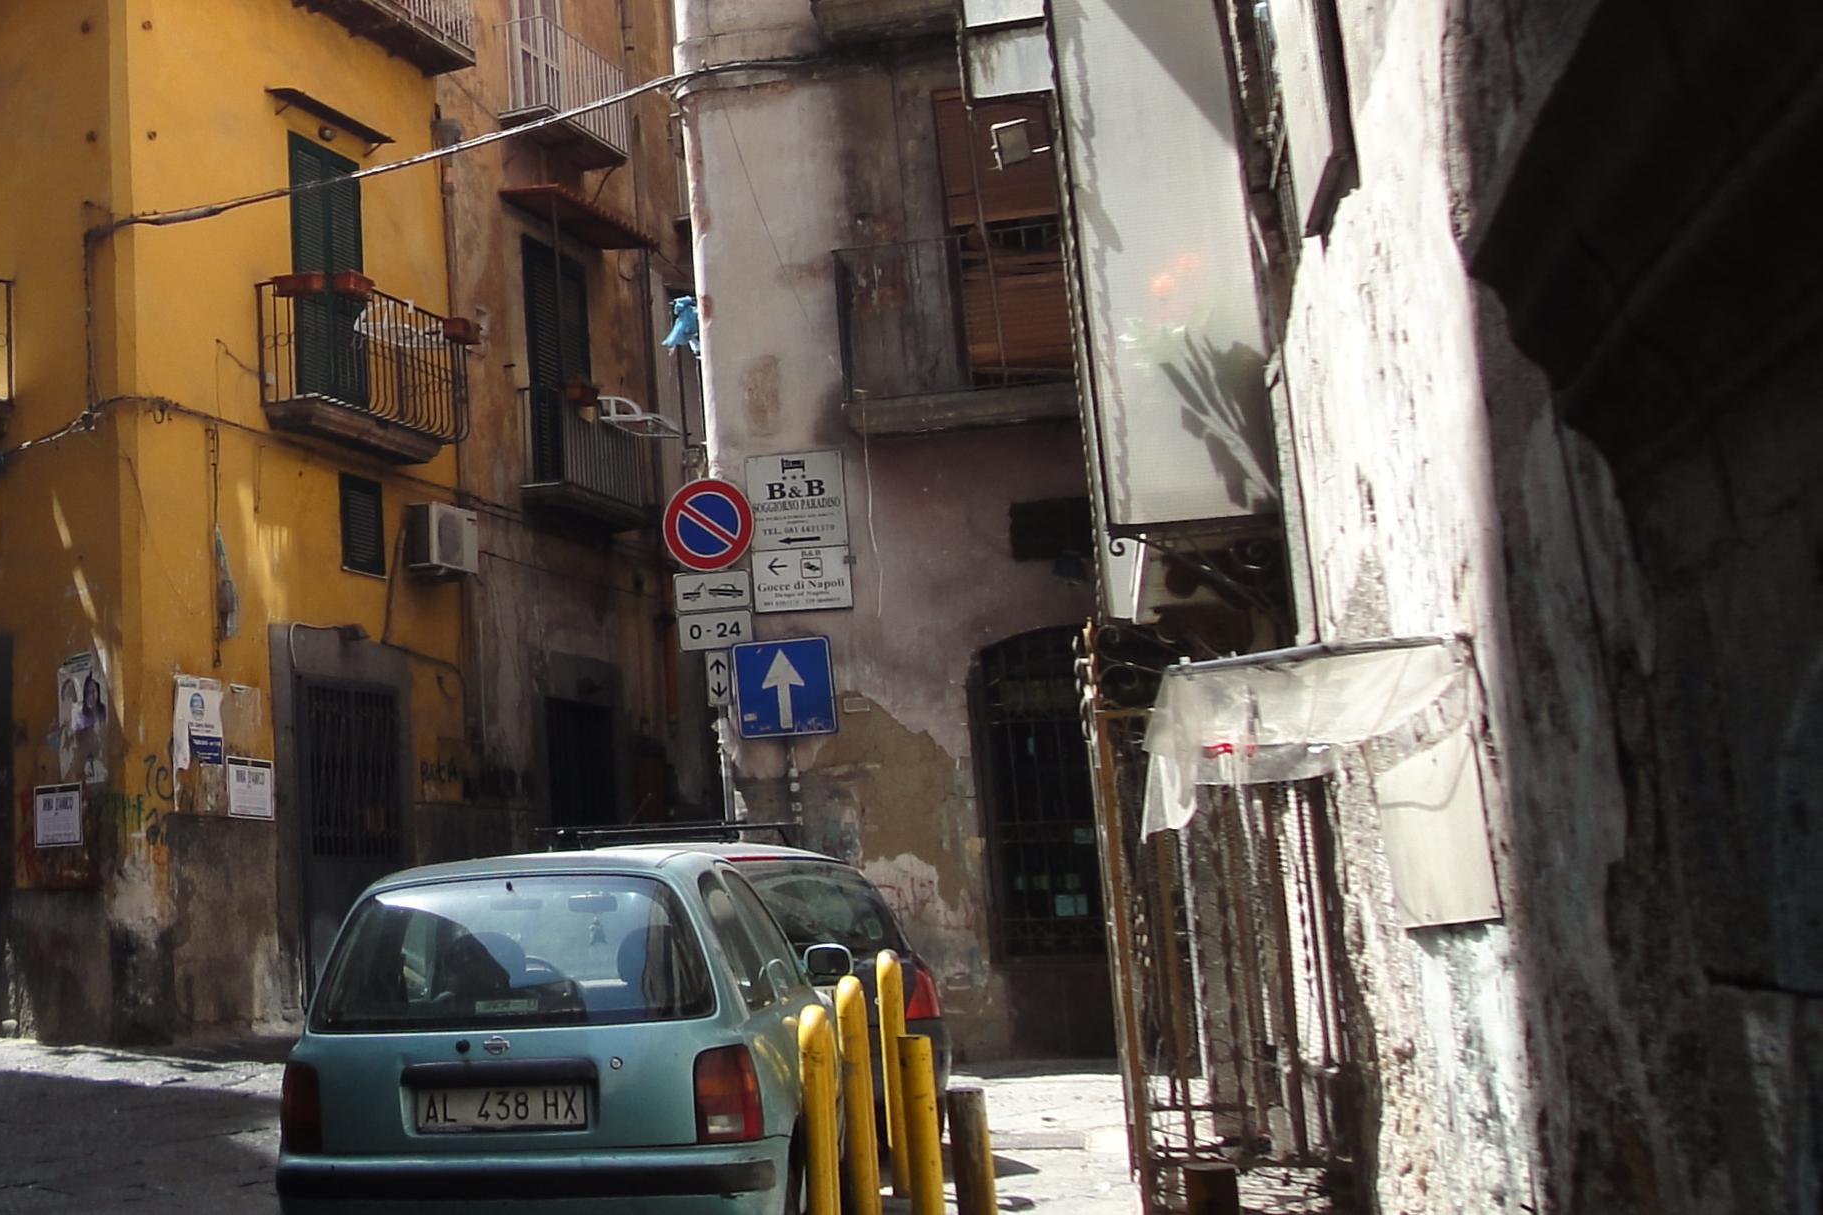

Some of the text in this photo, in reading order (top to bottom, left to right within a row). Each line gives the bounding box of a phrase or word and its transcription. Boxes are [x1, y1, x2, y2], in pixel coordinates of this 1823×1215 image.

[765, 479, 825, 500] B&B
[757, 577, 845, 592] Gocce di Napoli
[716, 621, 741, 638] 24
[425, 1089, 578, 1123] AL 438 HX
